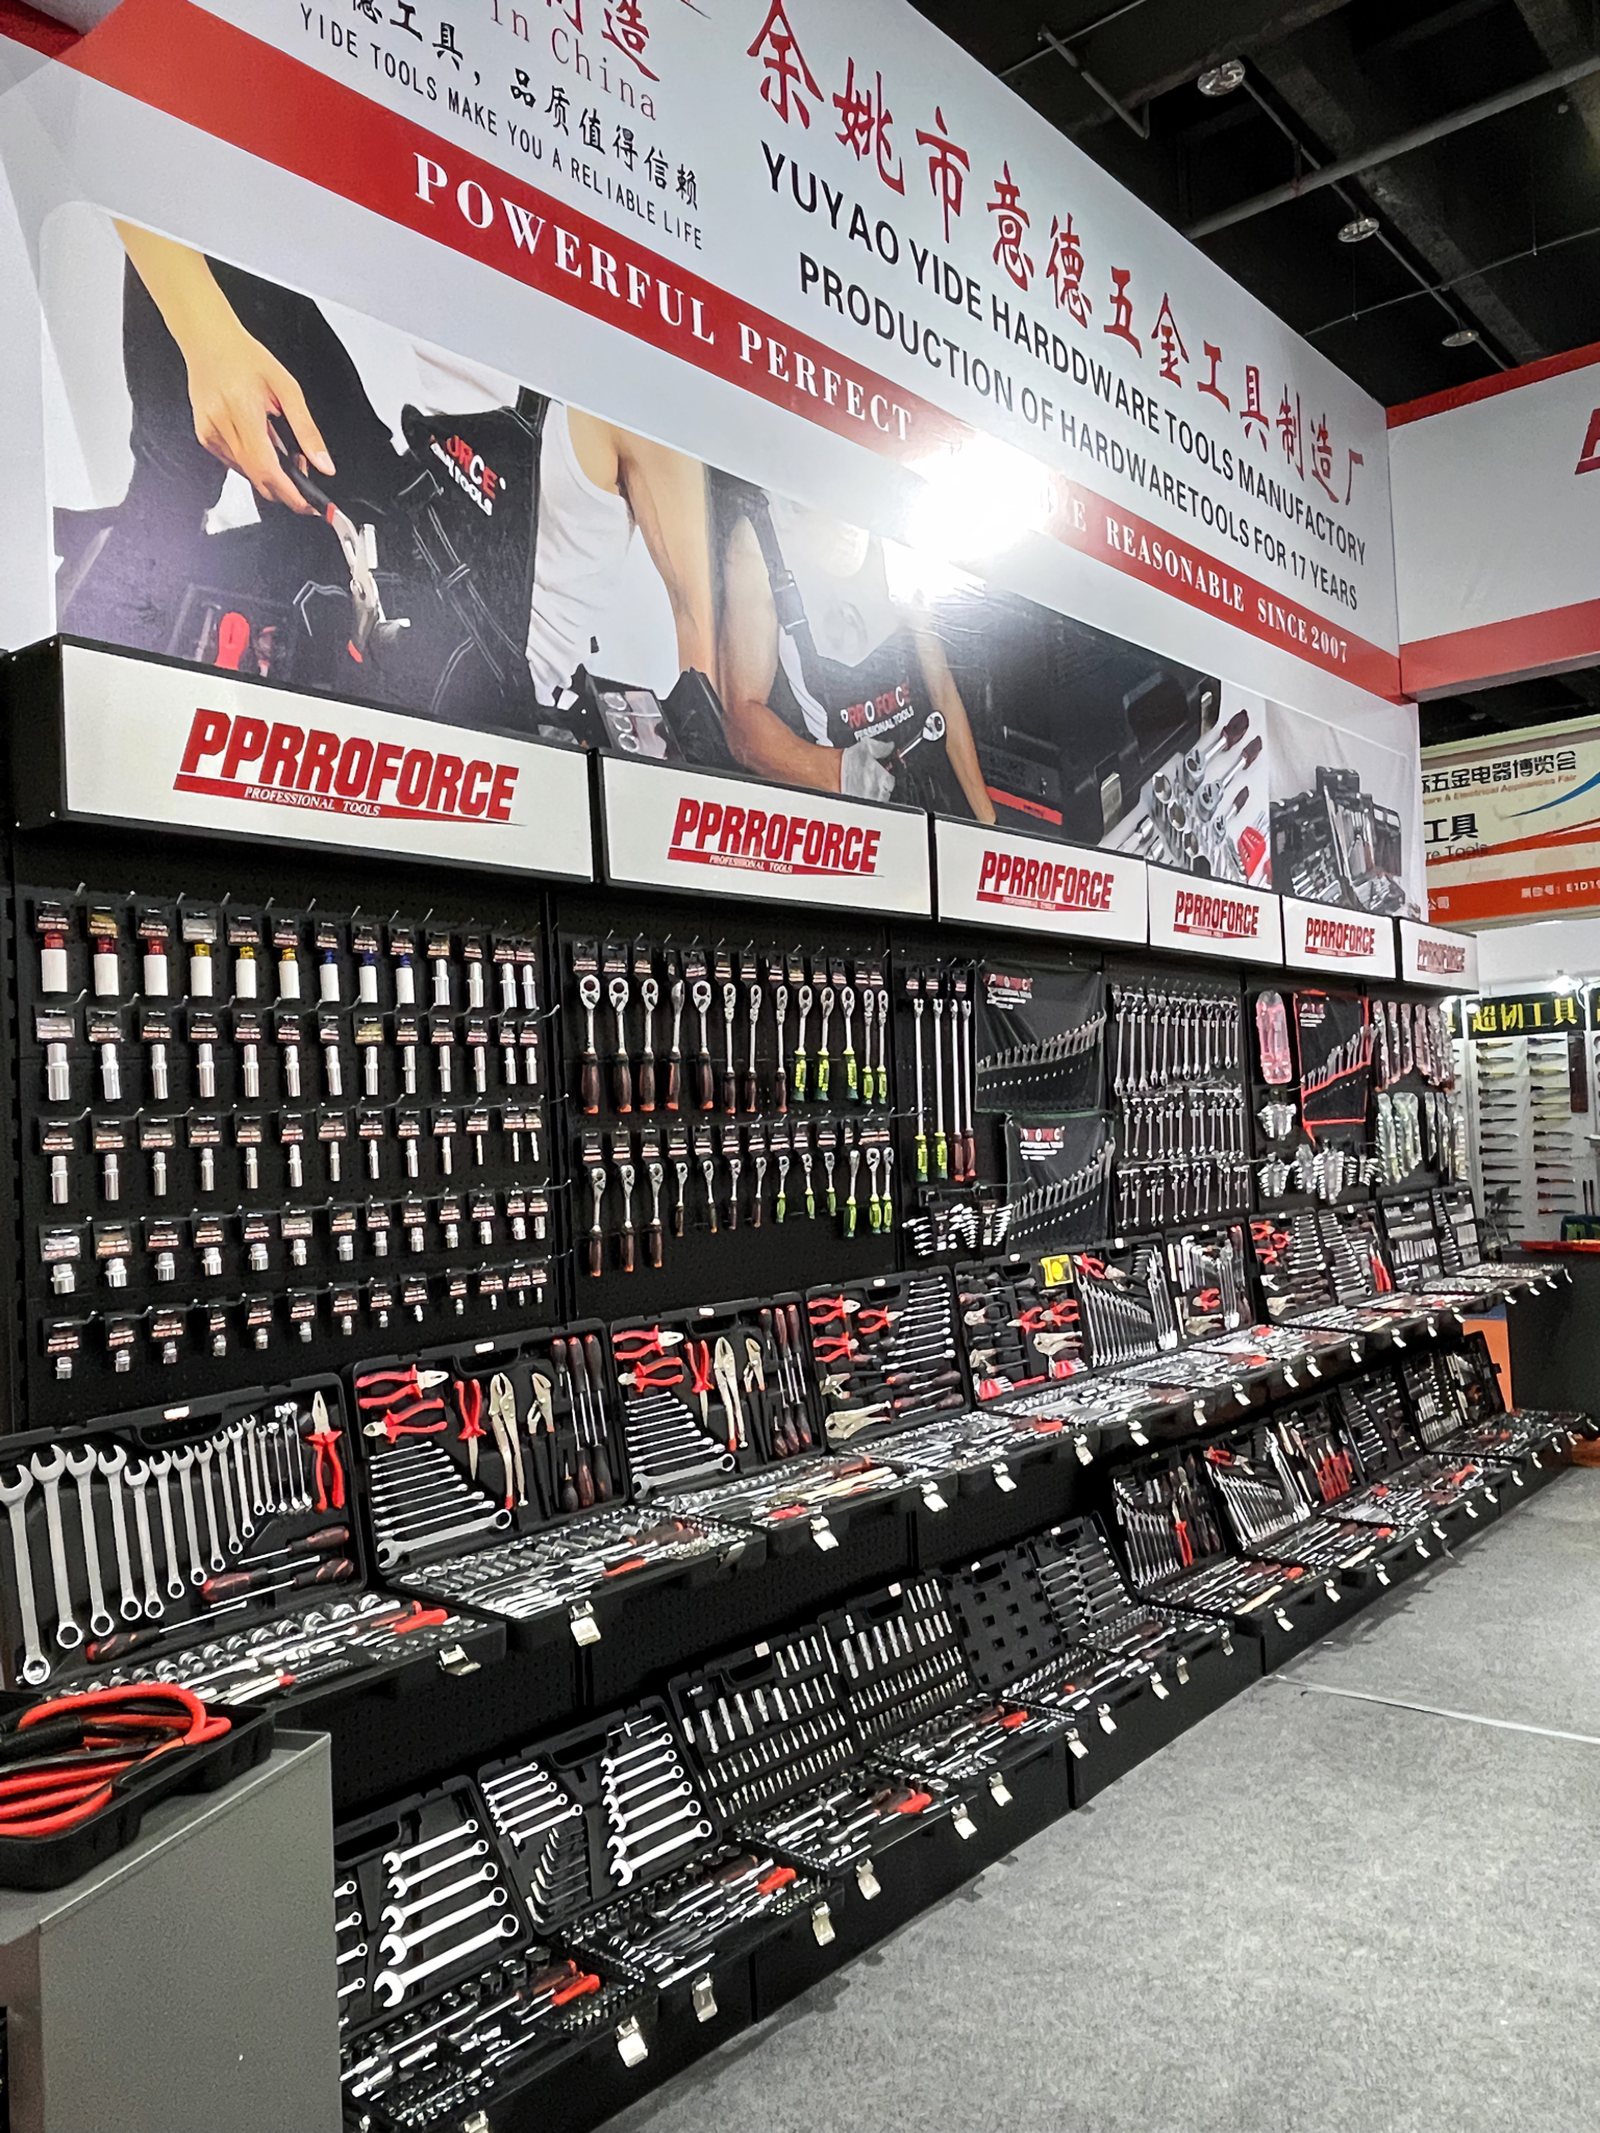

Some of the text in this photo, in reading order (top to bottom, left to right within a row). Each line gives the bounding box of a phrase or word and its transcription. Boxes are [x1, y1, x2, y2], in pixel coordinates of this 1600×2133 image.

[490, 0, 656, 121] In China
[546, 0, 660, 82] 造
[301, 3, 703, 250] YIDE TOOLS MAKE YOU A RELIABLE LIFE
[747, 0, 1364, 506] 余姚市意德五金工具制造厂
[412, 151, 1349, 664] POWERFUL PERFECT REASONABLE SINCE 2007
[760, 139, 1366, 566] YUYAO YIDE HARDDWARE TOOLS MANUFACTORY
[799, 252, 1013, 413] PRODUCTION
[1022, 387, 1054, 432] OF
[1254, 526, 1287, 565] FOR
[1290, 550, 1306, 581] 17
[1312, 559, 1359, 611] YEARS
[180, 708, 520, 822] PPRROFORCE
[244, 787, 382, 817] PROFESSIONAL TOOLS
[671, 797, 882, 874] PPRROFORCE
[979, 851, 1114, 910] PPRROFORCE
[1174, 890, 1260, 936] PPRROFORCE
